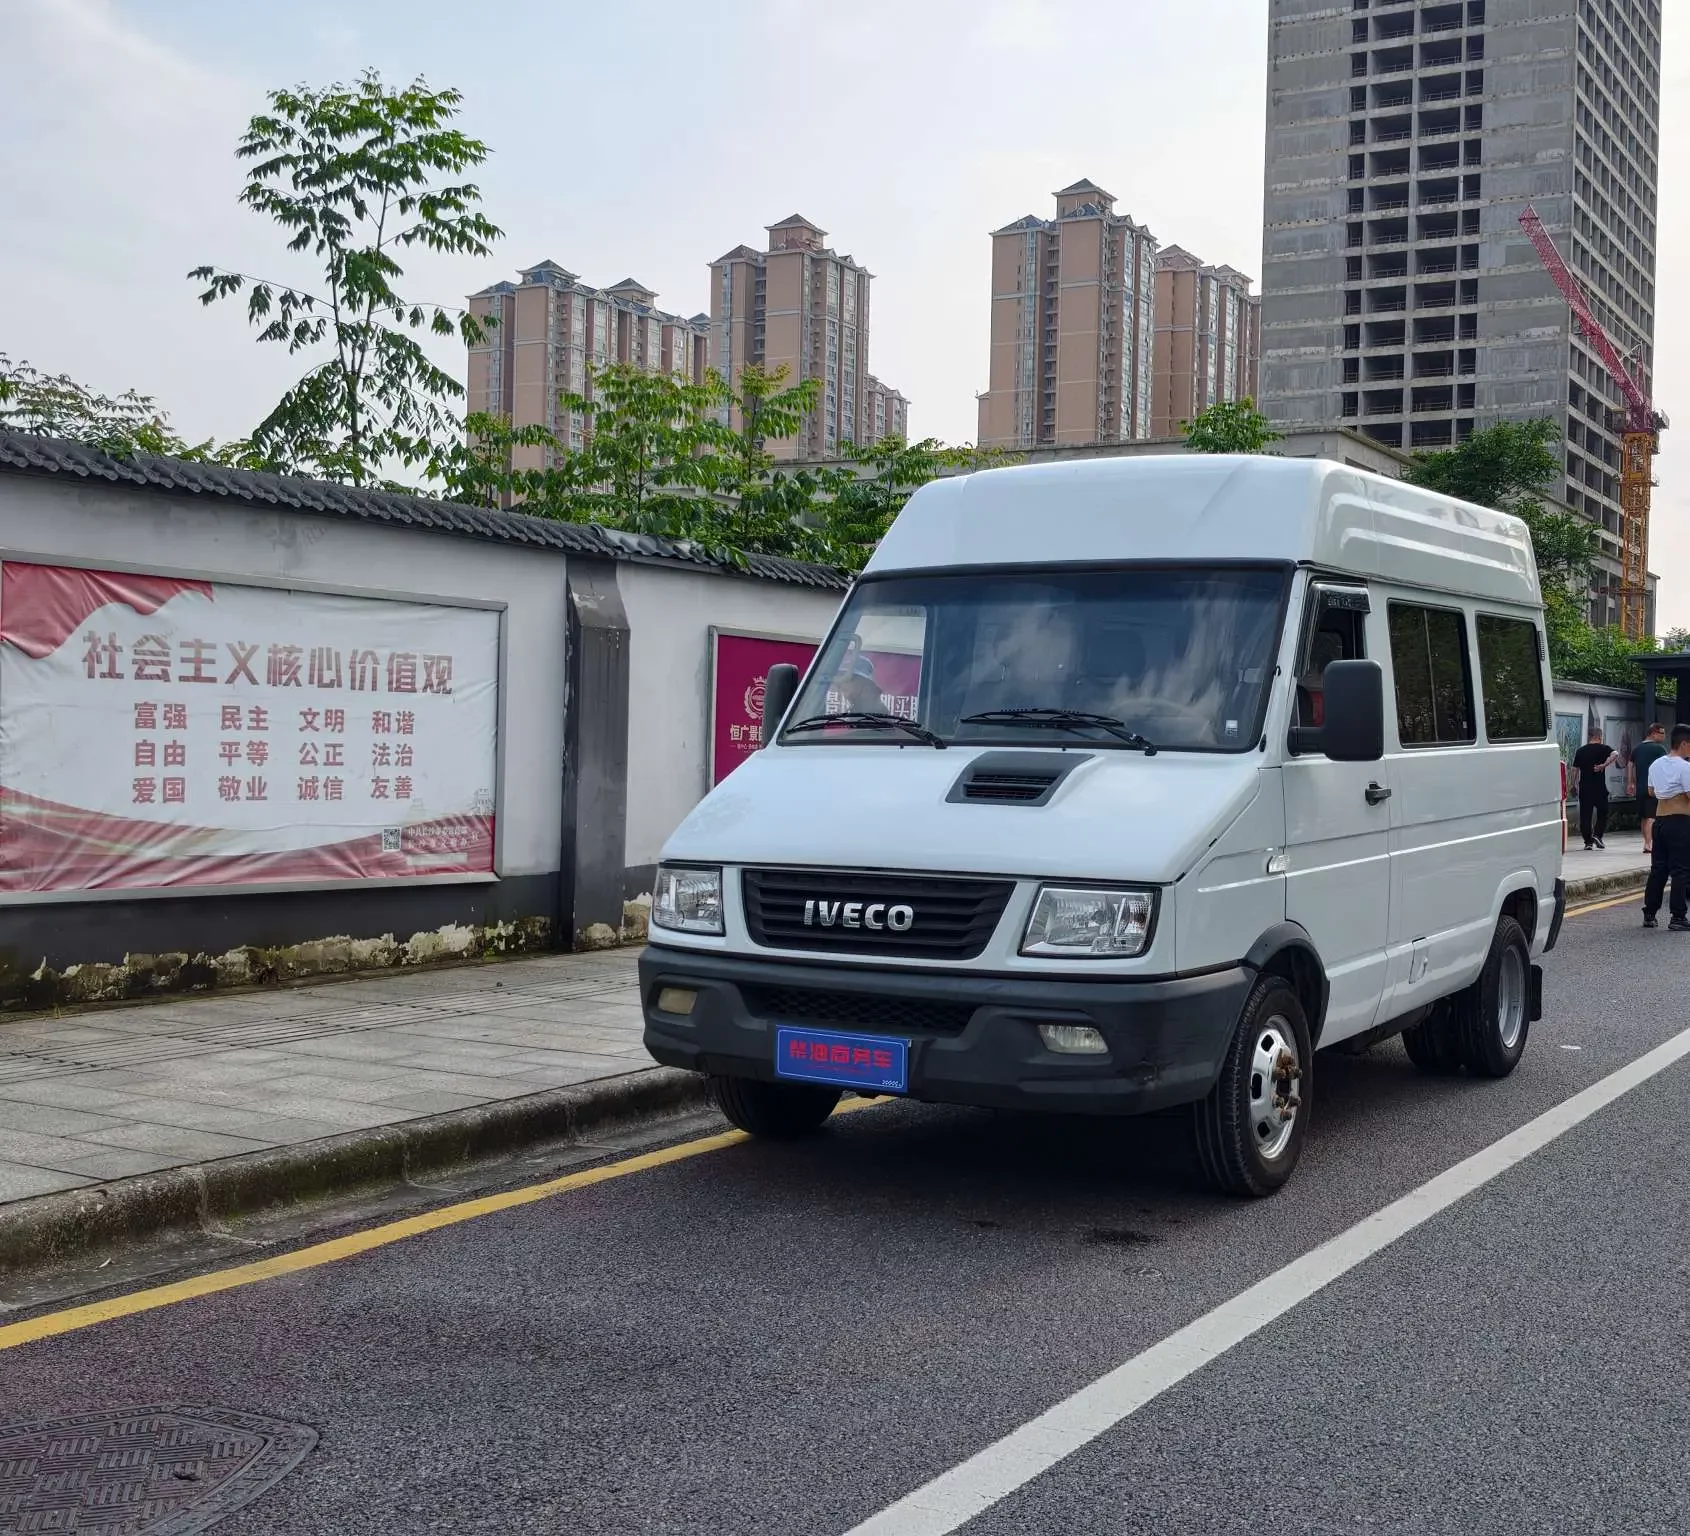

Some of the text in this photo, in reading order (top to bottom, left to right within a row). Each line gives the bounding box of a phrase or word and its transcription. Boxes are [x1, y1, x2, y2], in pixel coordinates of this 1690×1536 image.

[82, 629, 453, 694] 社会主义核心价值观
[134, 701, 415, 735] 富强 民主 文明 和谐
[134, 739, 414, 767] 自由 平等 公正 法治
[132, 776, 414, 803] 爱国 敬业 诚信 友善
[803, 899, 914, 931] IVECO
